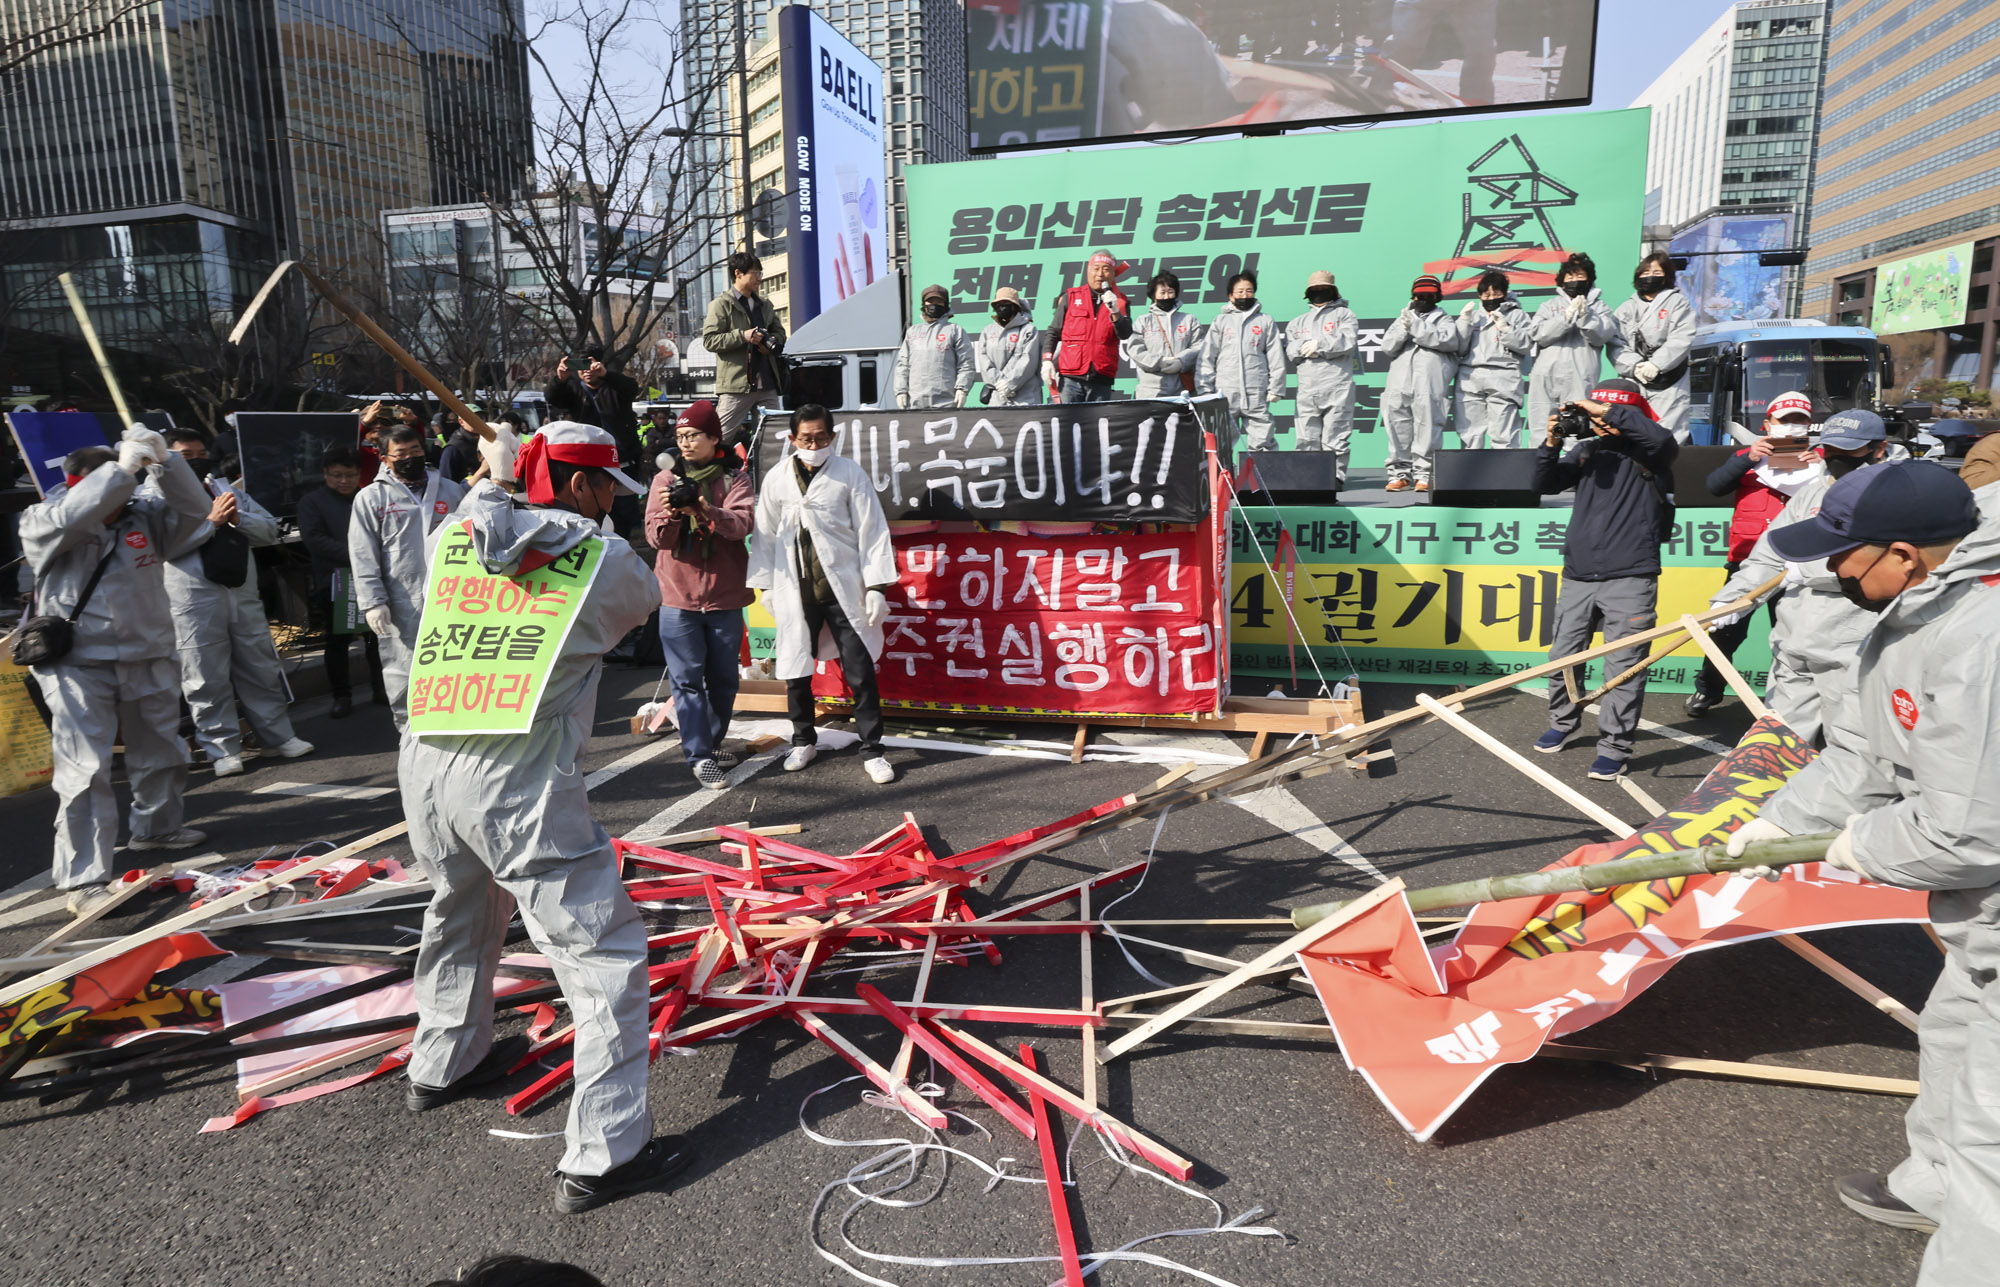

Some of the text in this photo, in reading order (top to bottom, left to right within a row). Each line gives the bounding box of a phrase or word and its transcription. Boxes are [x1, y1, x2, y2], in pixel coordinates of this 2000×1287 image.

[819, 45, 877, 125] BAELL
[797, 135, 812, 232] GLOW MODE ON
[407, 209, 487, 223] Immersive Art Exhibition
[947, 182, 1371, 256] 용인산단 송전선로
[950, 263, 1043, 315] 전면
[1590, 391, 1630, 403] 결사반대
[1296, 520, 1361, 554] 대화
[1373, 520, 1440, 555] 기구
[1452, 520, 1520, 555] 구성
[435, 574, 569, 617] 역행하는
[887, 543, 1184, 613] 만하지말고
[418, 623, 546, 666] 송전탑을
[875, 615, 1218, 696] 주권실행하
[1322, 656, 1392, 673] 국가산단
[1399, 658, 1471, 676] 재검토와
[1647, 666, 1686, 684] 반대
[411, 672, 532, 717] 철회하라
